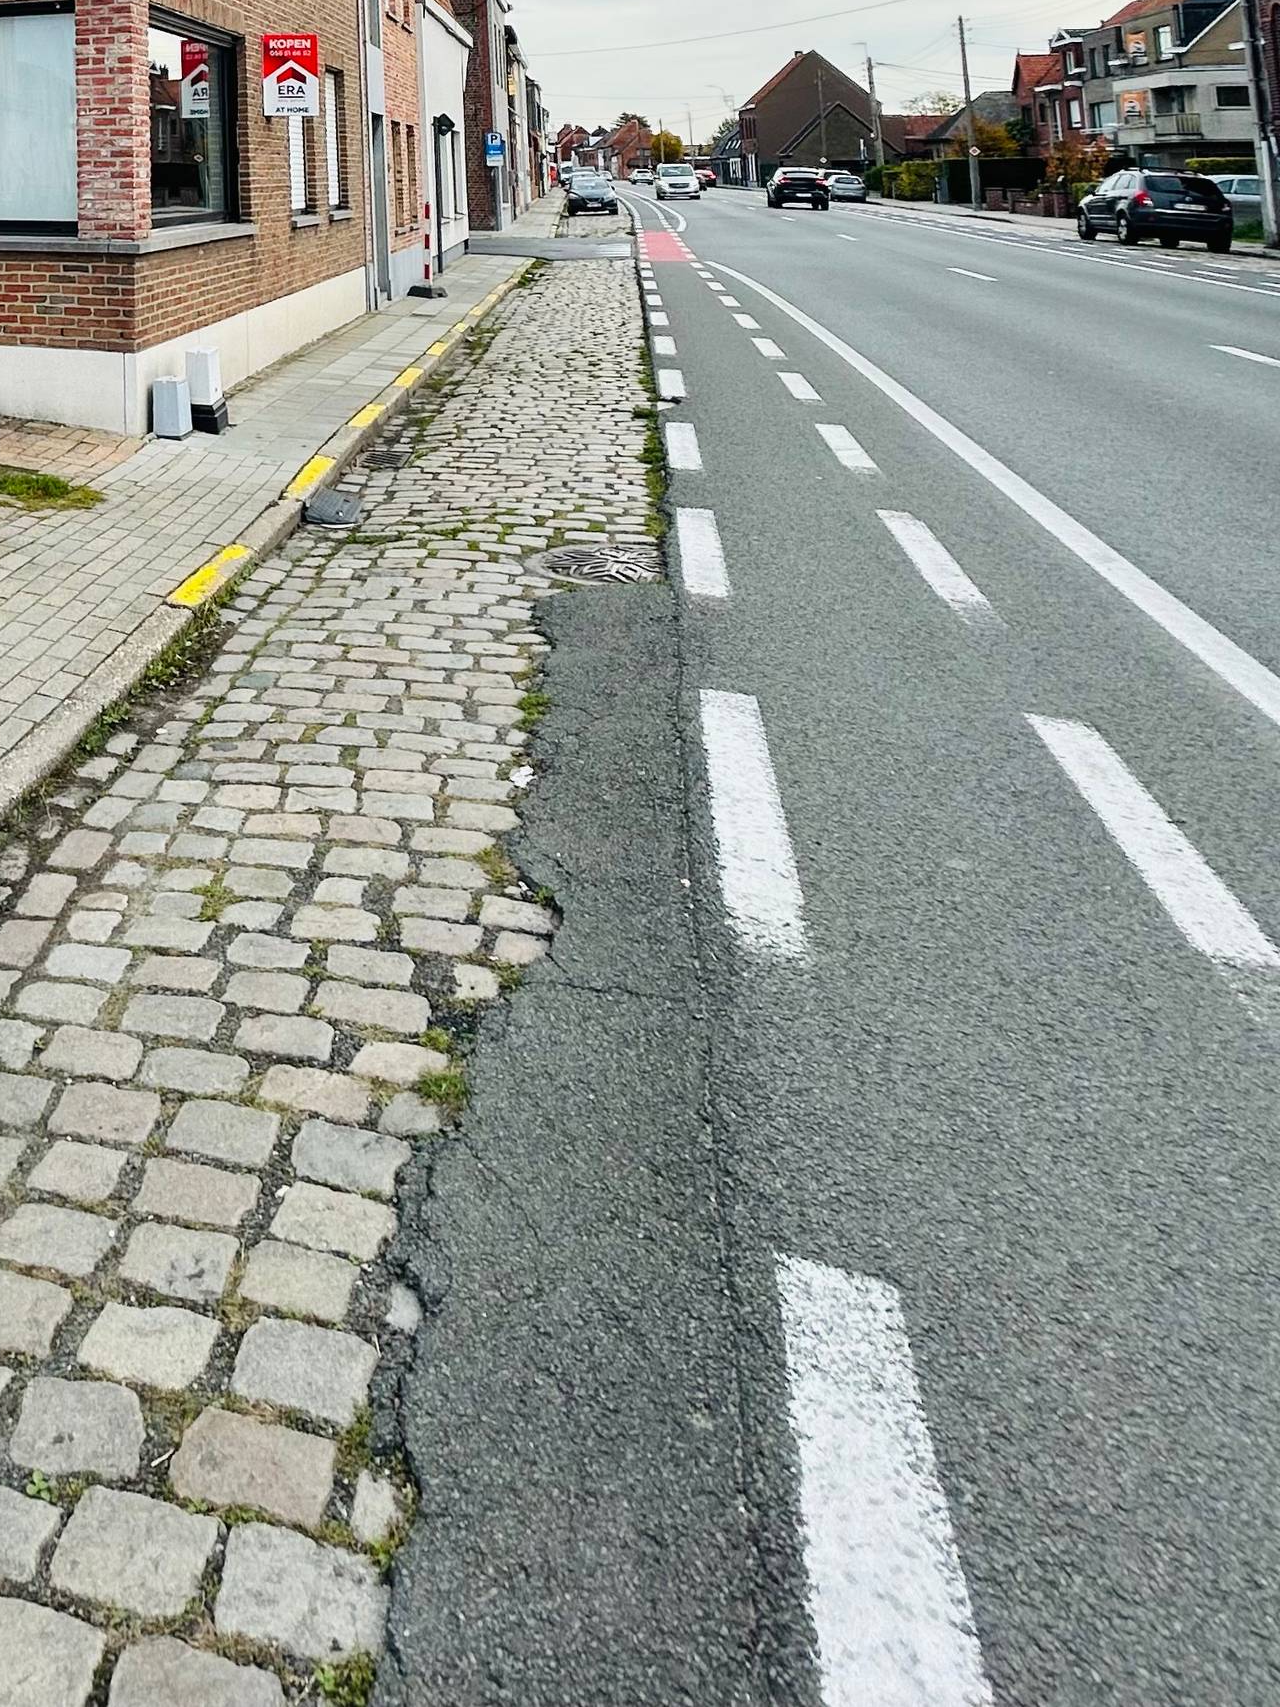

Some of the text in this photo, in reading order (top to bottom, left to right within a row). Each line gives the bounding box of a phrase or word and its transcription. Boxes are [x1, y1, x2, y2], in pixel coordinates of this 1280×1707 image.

[269, 39, 311, 49] KOPEN
[277, 85, 306, 95] ERA
[491, 135, 498, 143] P
